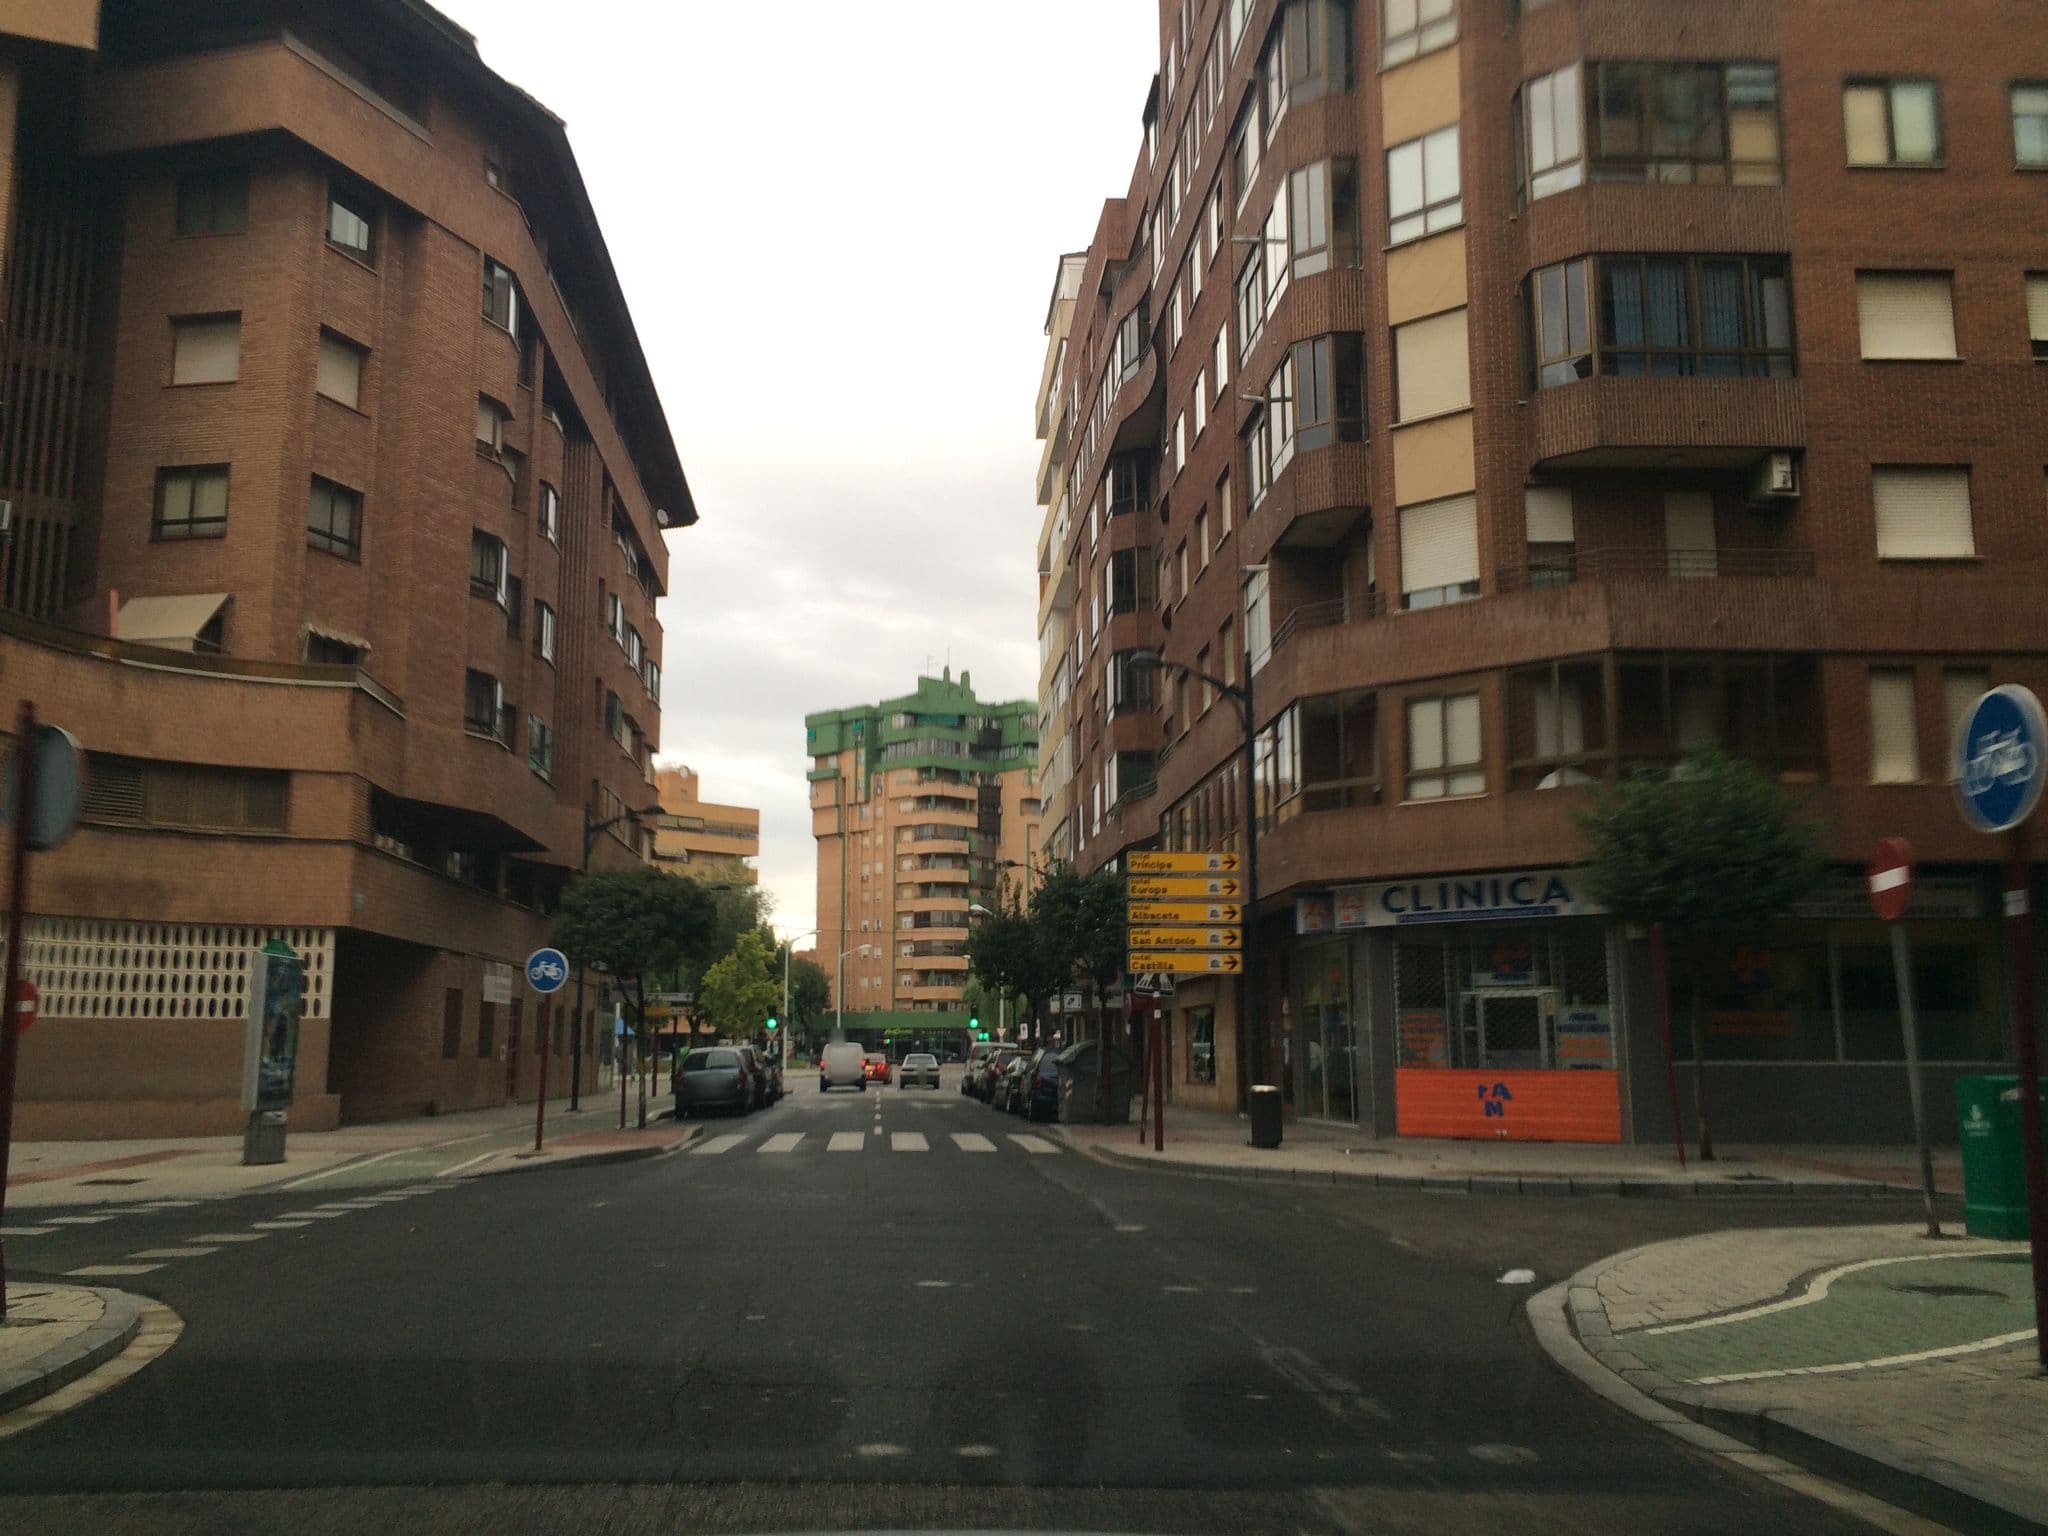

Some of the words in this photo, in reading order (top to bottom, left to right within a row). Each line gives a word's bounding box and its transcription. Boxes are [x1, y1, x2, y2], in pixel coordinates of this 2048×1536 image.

[1131, 886, 1167, 894] Europa
[1382, 876, 1571, 912] CLINICA
[1132, 911, 1180, 919] Albacete
[1132, 936, 1152, 945] San
[1155, 936, 1197, 945] Antonio
[1132, 961, 1174, 970] Castilla
